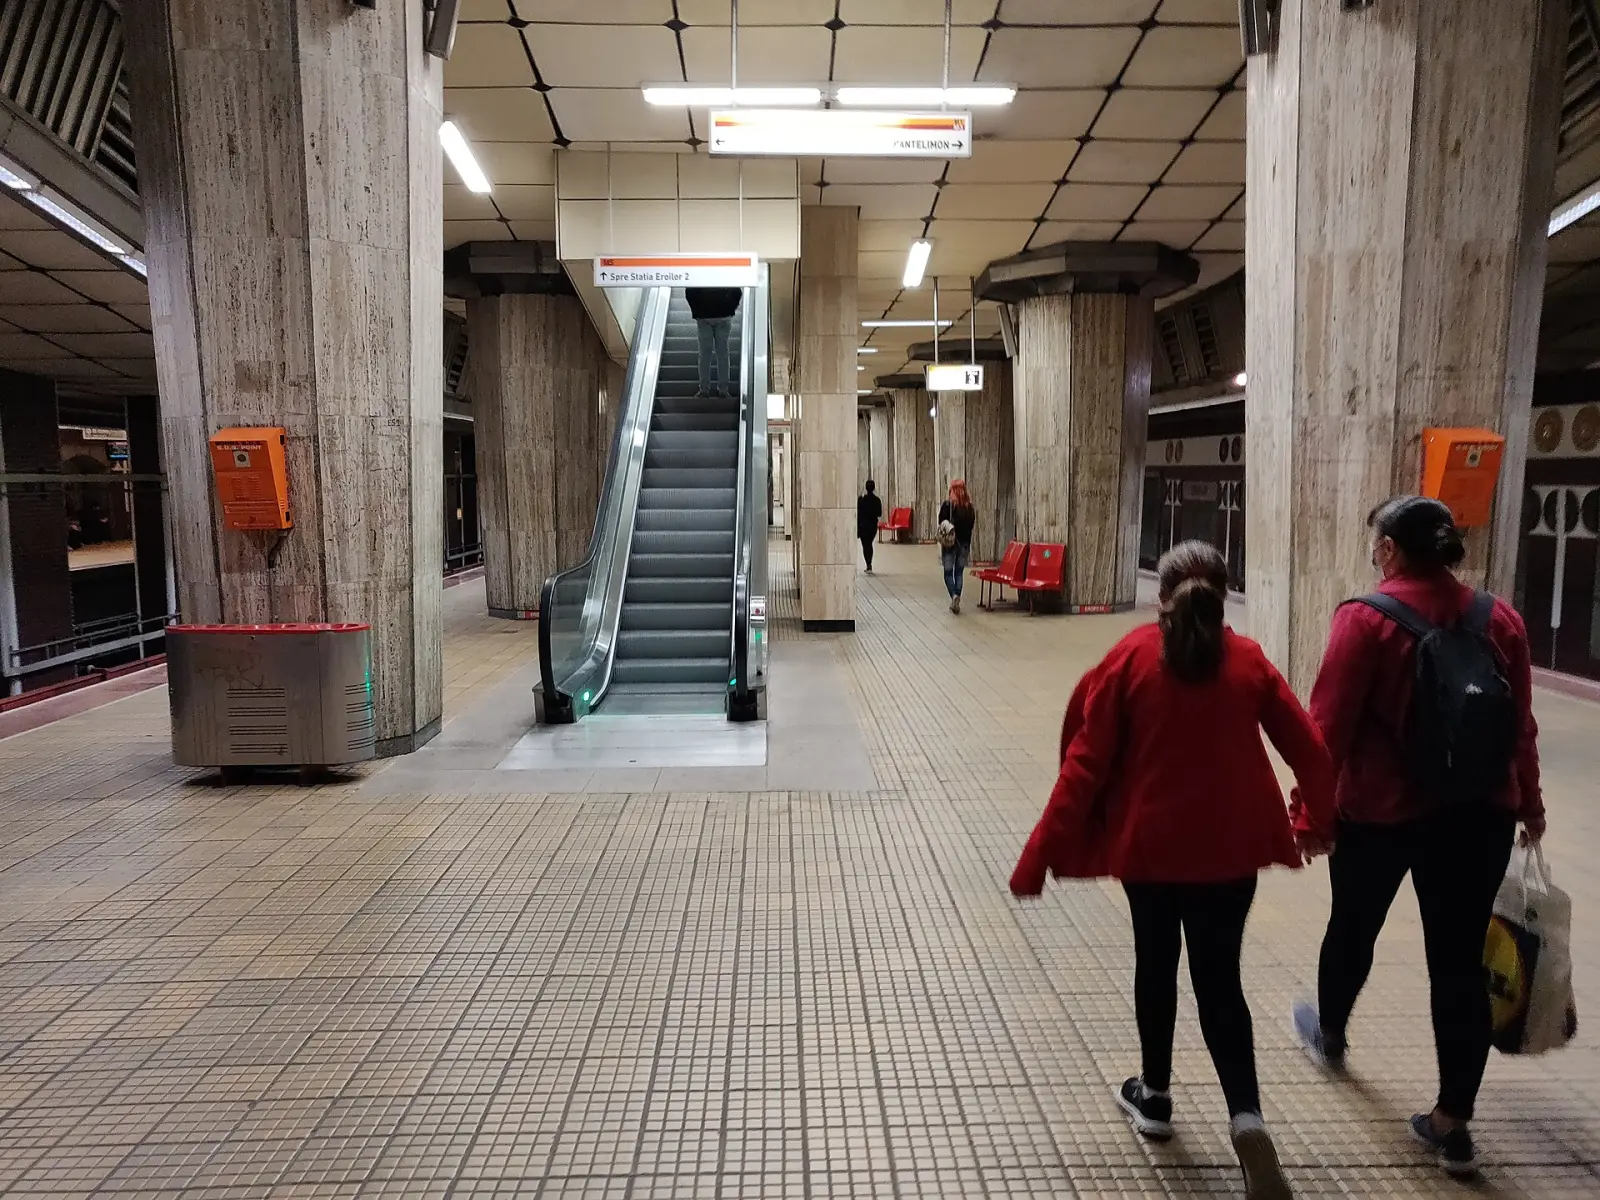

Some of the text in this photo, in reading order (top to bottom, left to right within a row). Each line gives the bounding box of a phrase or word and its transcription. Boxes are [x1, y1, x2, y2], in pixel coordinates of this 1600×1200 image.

[610, 272, 690, 282] Spre Statia Eroilor 2
